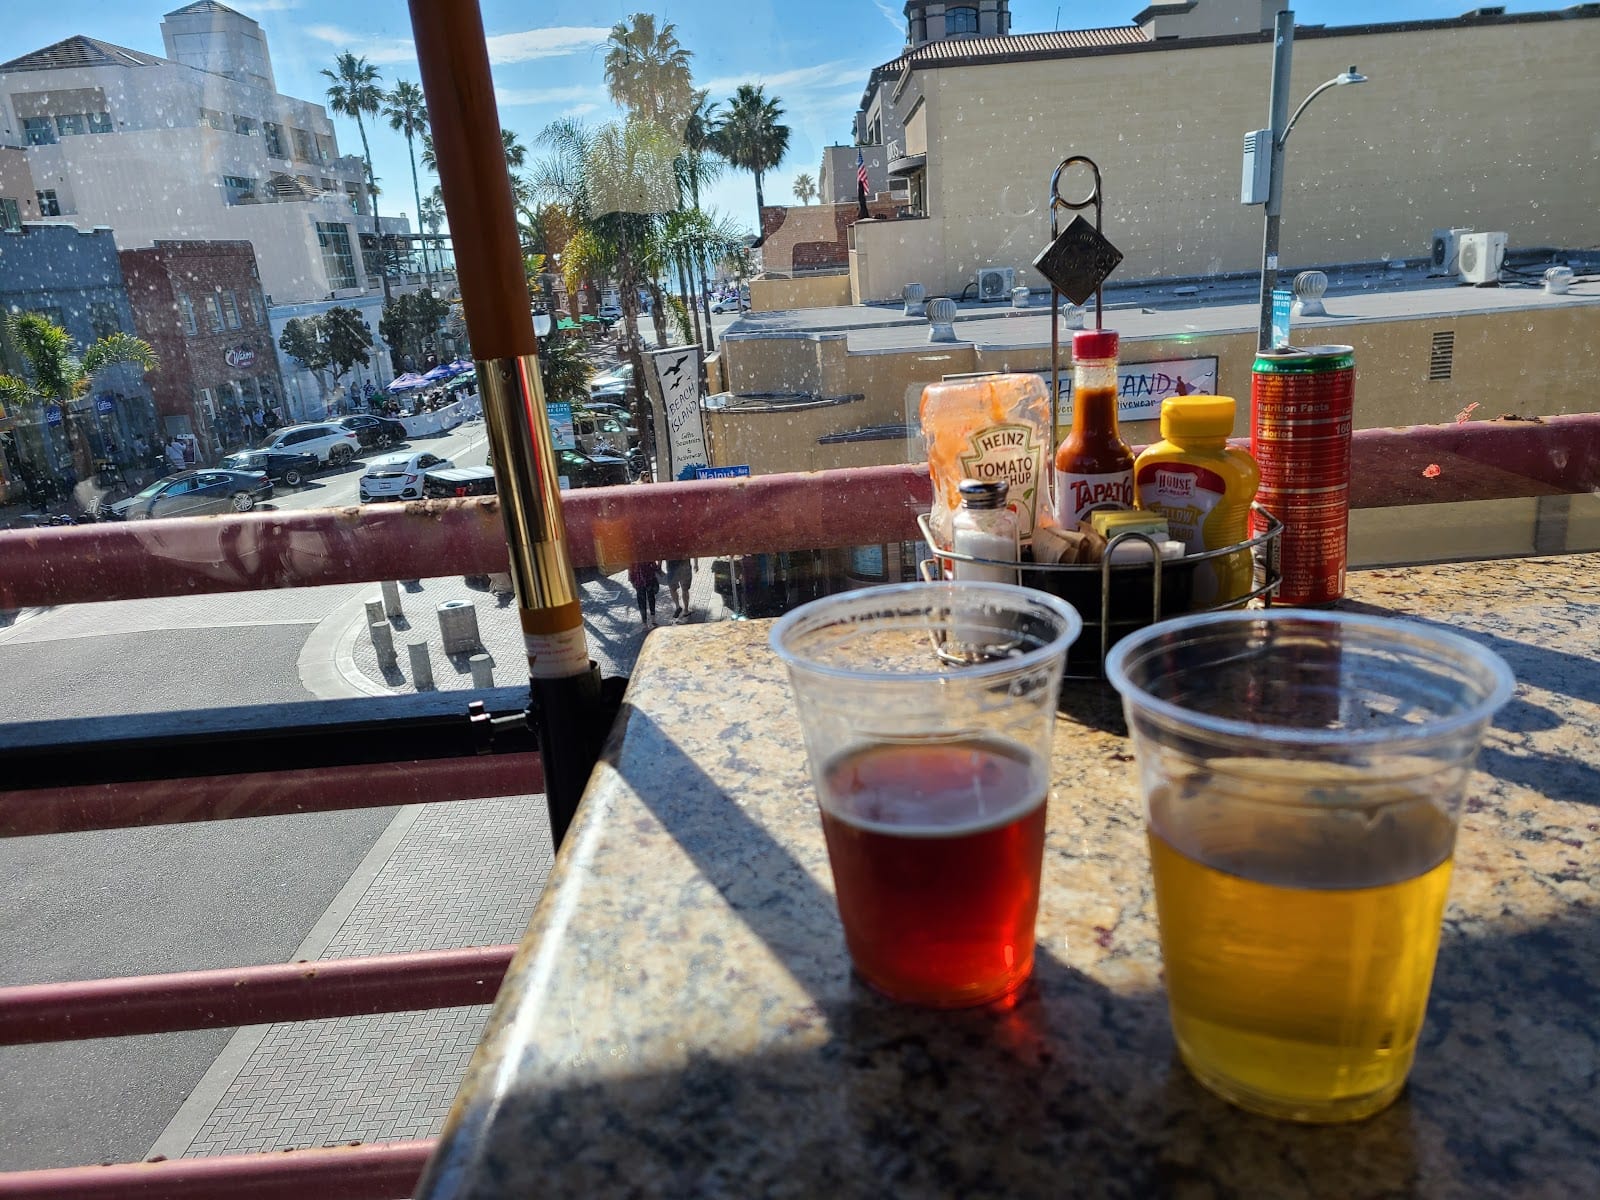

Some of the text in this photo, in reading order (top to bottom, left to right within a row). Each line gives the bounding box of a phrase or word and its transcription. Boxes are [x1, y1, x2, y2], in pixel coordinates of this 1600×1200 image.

[668, 382, 696, 416] BEACH
[1257, 402, 1330, 413] Nutrition Facts
[671, 400, 697, 433] ISLAND
[981, 432, 1025, 451] HEINZ
[1257, 428, 1294, 438] Calories
[699, 467, 748, 480] Walnut Ave
[975, 456, 1033, 477] TOMATO
[1159, 473, 1192, 490] HOUSE
